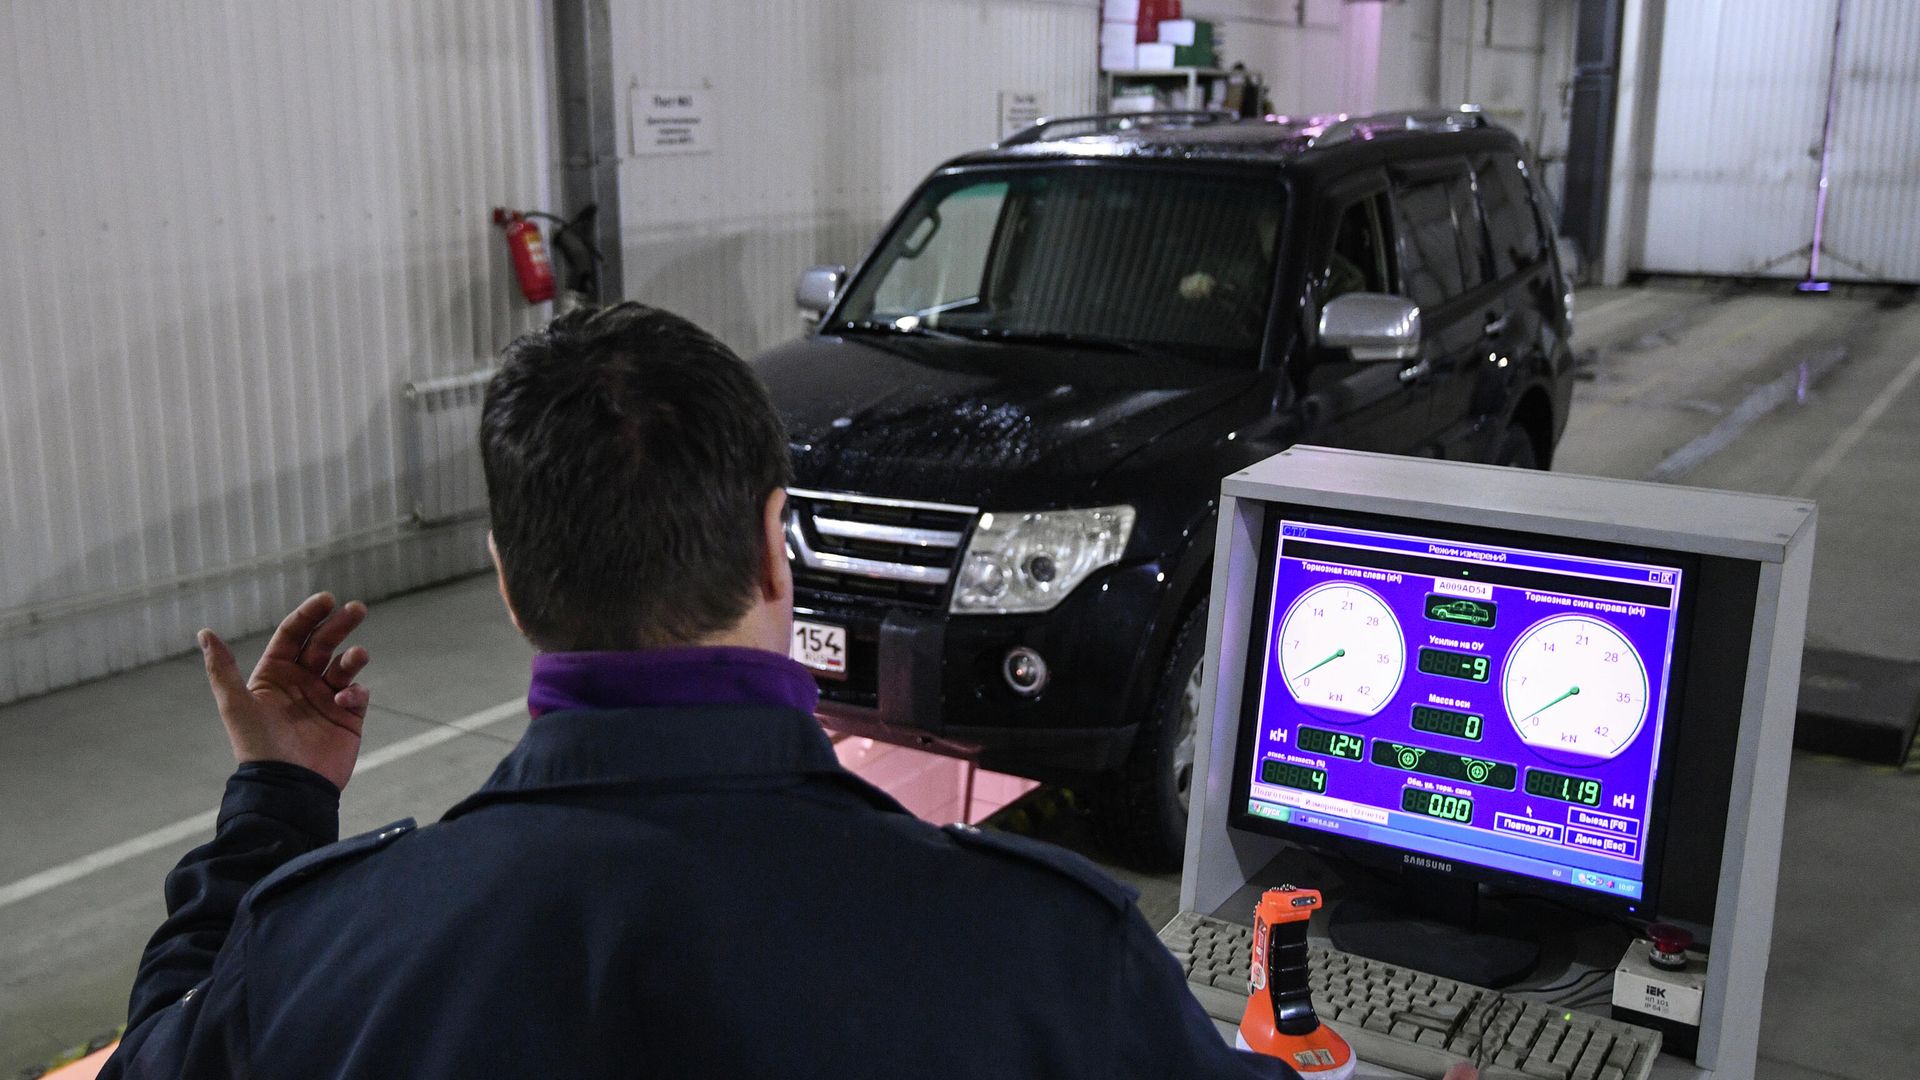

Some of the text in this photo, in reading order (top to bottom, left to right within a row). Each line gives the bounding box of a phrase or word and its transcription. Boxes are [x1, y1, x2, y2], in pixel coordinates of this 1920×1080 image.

[1428, 544, 1507, 563] Режим измерений
[1302, 561, 1343, 575] Тормозная
[1343, 568, 1361, 578] сила
[1363, 571, 1386, 581] слева
[1341, 600, 1353, 611] 21
[1525, 591, 1572, 607] Тормозная
[1573, 599, 1594, 609] сила
[1595, 602, 1627, 614] справа
[1313, 608, 1324, 617] 14
[1366, 616, 1379, 626] 28
[797, 627, 842, 655] 154
[1294, 639, 1300, 649] 7
[1460, 641, 1471, 649] на
[1471, 641, 1484, 651] ОУ
[1575, 635, 1589, 646] 21
[1543, 642, 1555, 652] 14
[1376, 654, 1390, 664] 35
[1603, 651, 1619, 663] 28
[1462, 657, 1487, 680] -9
[1304, 677, 1310, 687] 0
[1521, 676, 1527, 686] 7
[1357, 685, 1371, 696] 42
[1329, 692, 1343, 702] kN
[1428, 693, 1471, 709] Масса оси
[1616, 692, 1631, 703] 35
[1464, 716, 1480, 738] 0
[1532, 716, 1539, 727] 0
[1269, 728, 1288, 743] кН
[1594, 726, 1609, 737] 42
[1561, 732, 1577, 743] kN
[1287, 754, 1316, 766] разность
[1312, 771, 1324, 790] 4
[1613, 793, 1635, 810] кН
[1263, 807, 1281, 817] пуск
[1503, 818, 1537, 834] Повтор
[1579, 813, 1608, 828] Выезд
[1575, 833, 1602, 847] Далее
[1403, 854, 1452, 872] SAMSUNG
[1646, 984, 1666, 998] IEK
